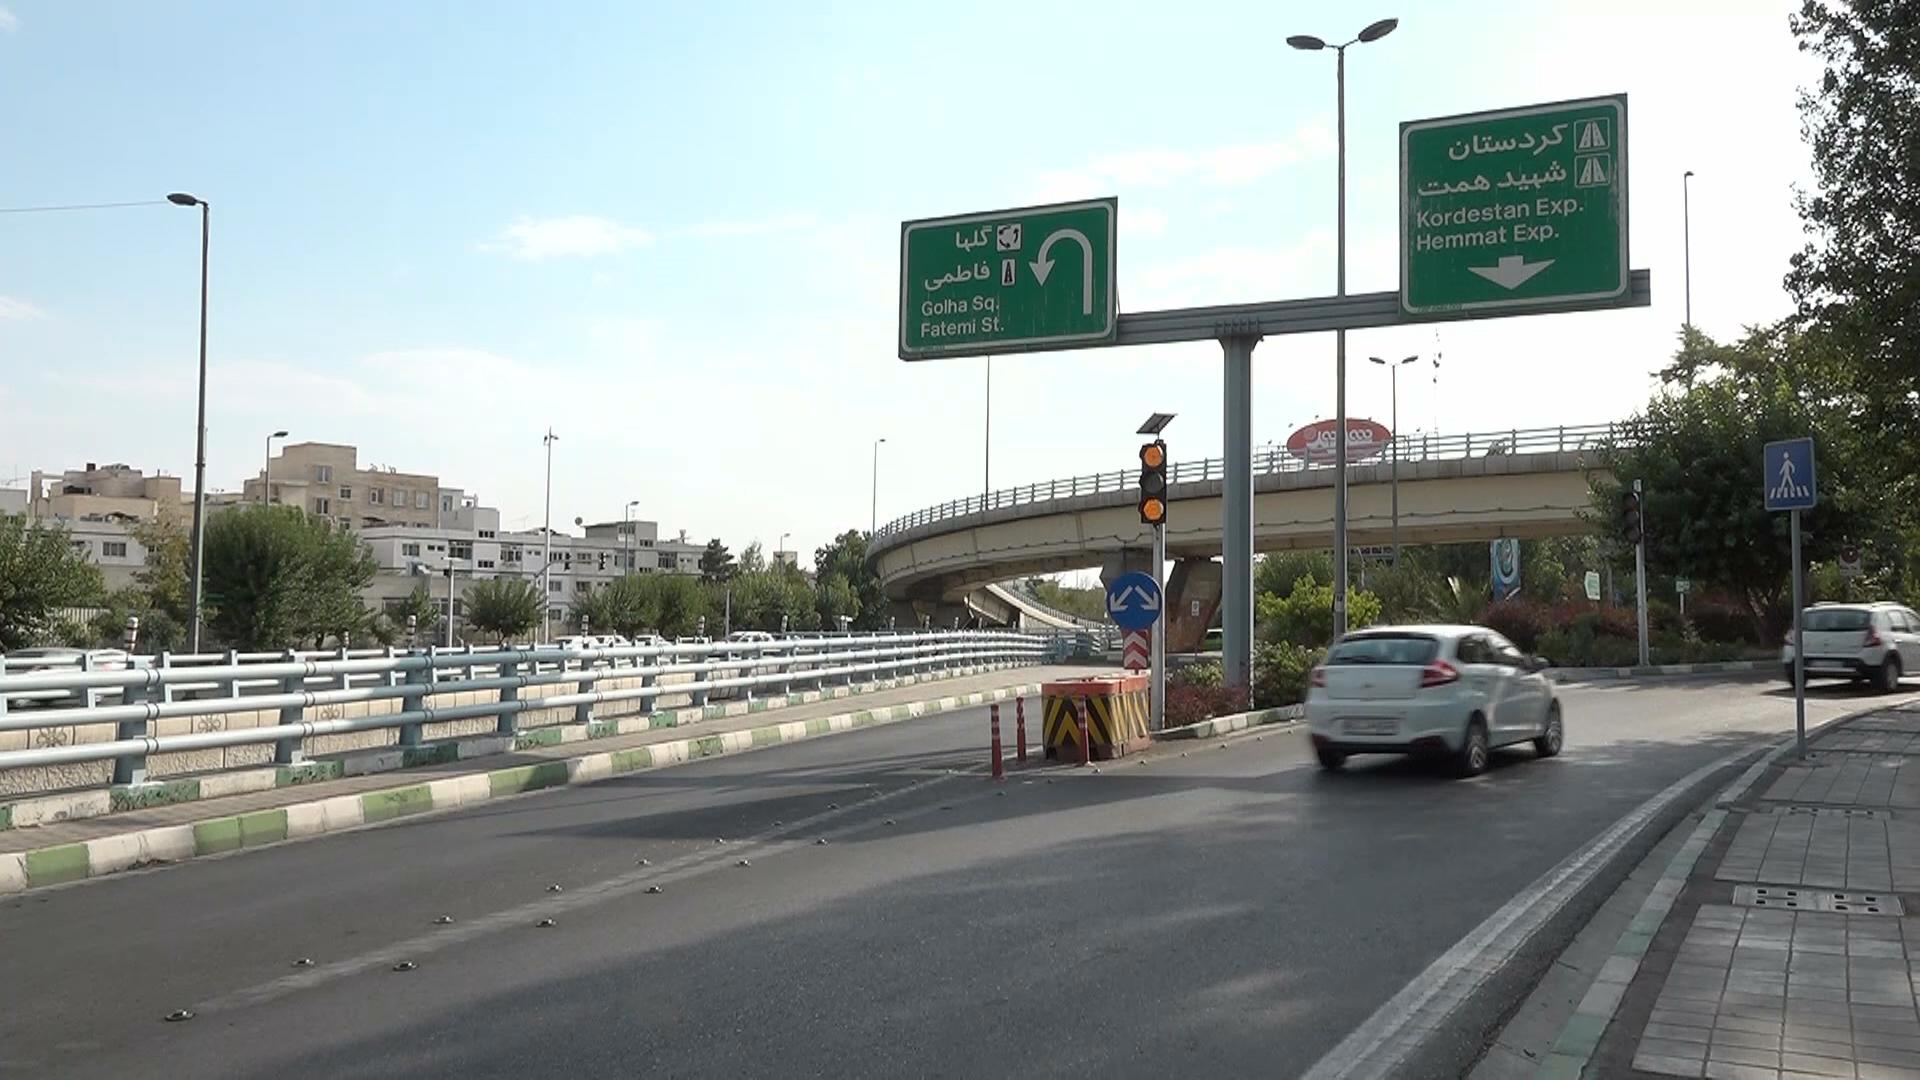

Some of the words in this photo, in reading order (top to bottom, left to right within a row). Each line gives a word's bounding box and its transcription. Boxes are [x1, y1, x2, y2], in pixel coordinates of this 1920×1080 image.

[1448, 123, 1569, 161] کردستان
[1417, 174, 1491, 196] همت
[1497, 160, 1567, 191] شهید
[1416, 202, 1530, 228] Kordestan
[1536, 198, 1584, 216] Exp.
[955, 225, 992, 252] گلها
[1416, 226, 1507, 251] Hemmat
[1513, 224, 1560, 242] Exp.
[924, 260, 991, 291] فاطمی
[921, 298, 968, 317] Golha
[972, 295, 1000, 313] Sq.
[921, 319, 976, 338] Fatemi
[981, 316, 1004, 333] St.
